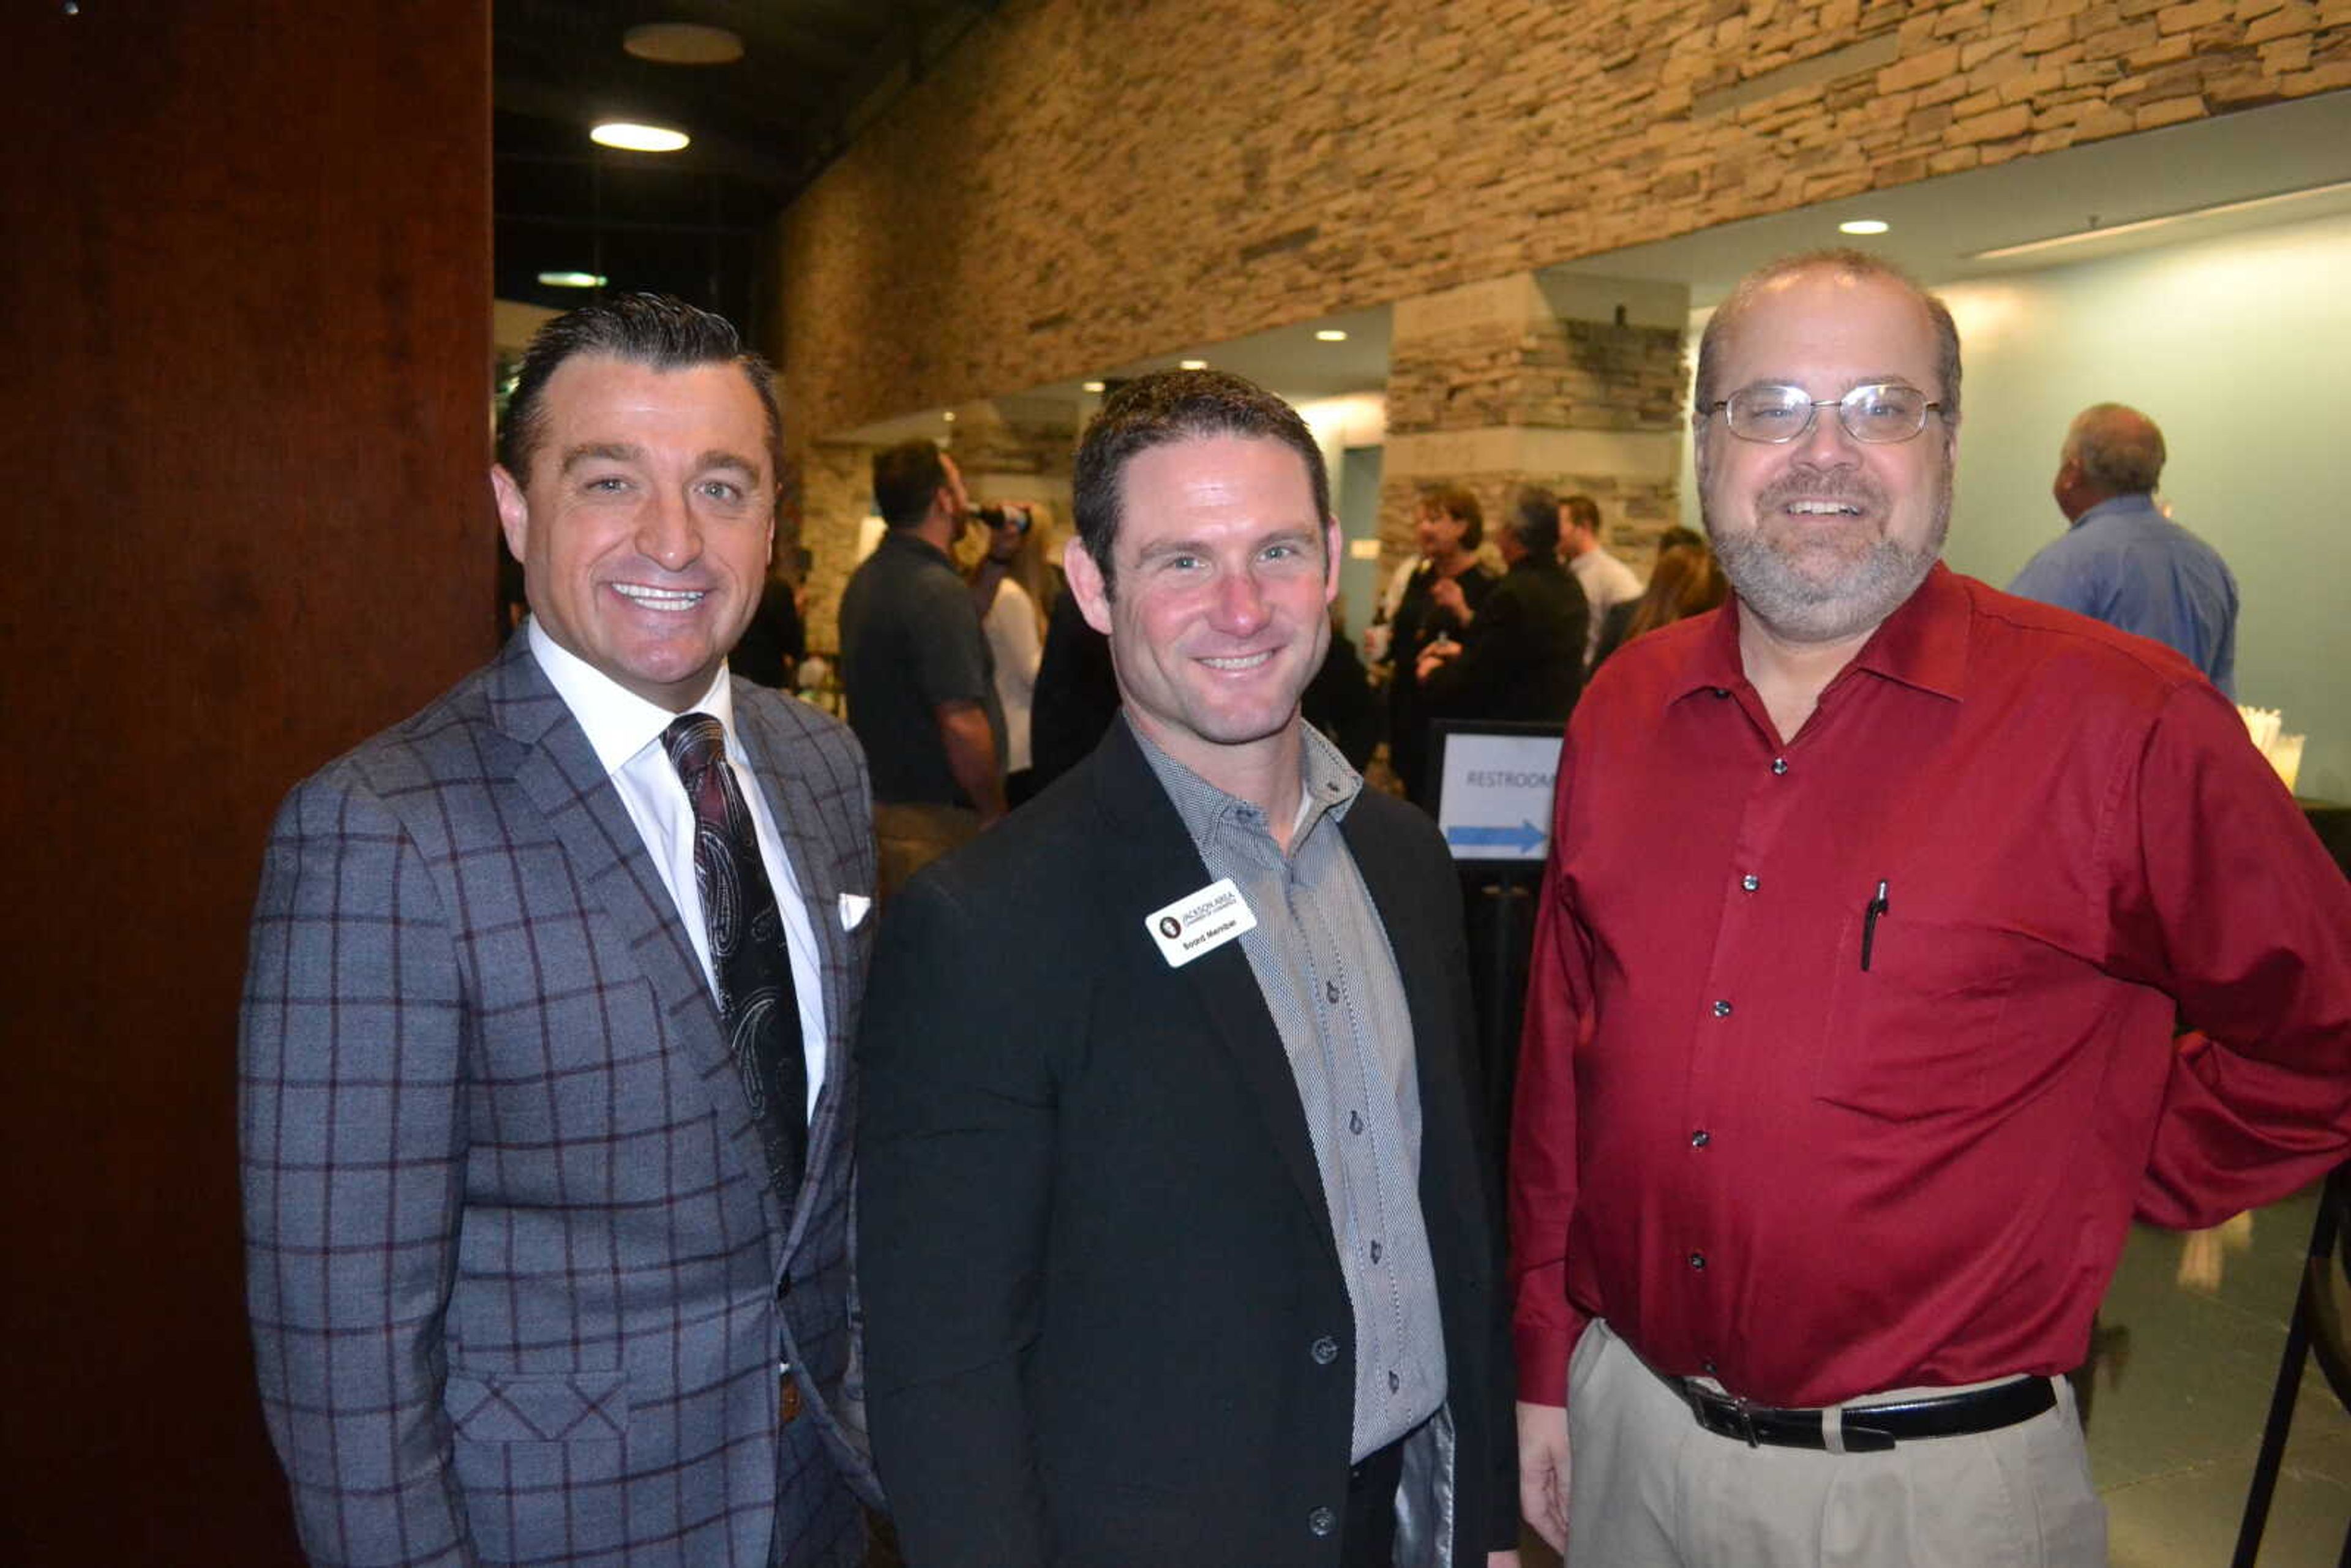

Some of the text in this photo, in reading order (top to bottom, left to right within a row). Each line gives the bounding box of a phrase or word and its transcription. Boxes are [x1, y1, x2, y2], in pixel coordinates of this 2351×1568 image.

[1183, 901, 1214, 921] JACKSON
[1183, 920, 1236, 950] Board Member
